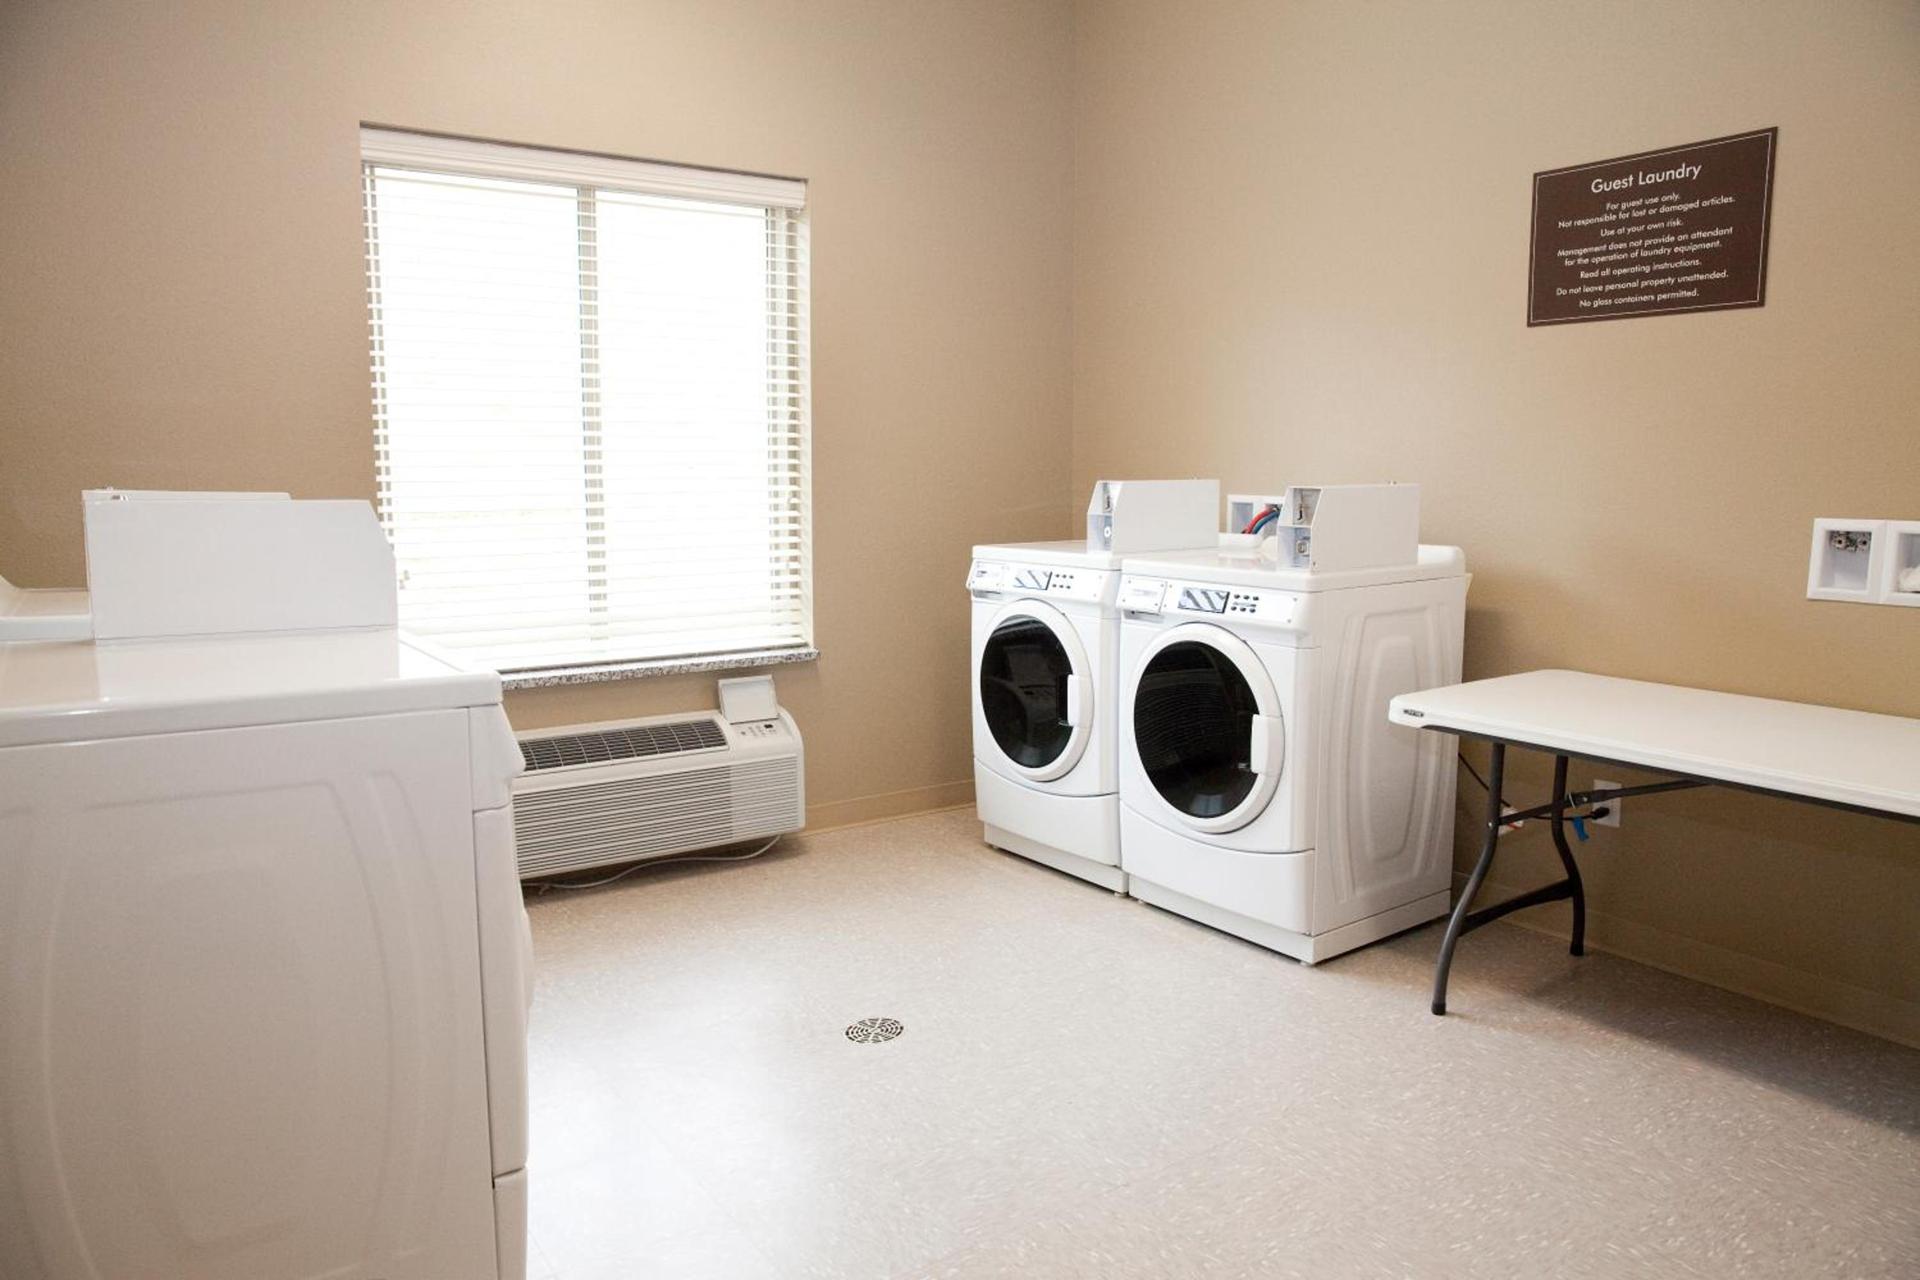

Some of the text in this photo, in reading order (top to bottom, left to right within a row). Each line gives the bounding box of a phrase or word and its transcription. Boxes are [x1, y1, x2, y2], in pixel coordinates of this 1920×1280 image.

[1591, 162, 1702, 193] Guest Laundry
[1558, 220, 1573, 228] Not
[1574, 213, 1616, 226] responsible
[1618, 211, 1630, 219] for
[1632, 208, 1647, 217] lost
[1660, 200, 1700, 214] damaged
[1702, 195, 1735, 206] articles.
[1606, 202, 1620, 210] For
[1622, 198, 1643, 210] guest
[1661, 192, 1680, 202] only.
[1600, 228, 1616, 236] Use
[1627, 225, 1645, 234] your
[1647, 222, 1664, 230] own
[1666, 218, 1683, 227] risk.
[1557, 244, 1606, 257] Management
[1608, 242, 1627, 250] does
[1628, 239, 1642, 247] not
[1644, 235, 1675, 247] provide
[1690, 227, 1733, 240] attendant
[1564, 258, 1576, 266] for
[1591, 252, 1628, 264] operation
[1630, 249, 1640, 258] of
[1640, 246, 1672, 257] laundry
[1674, 240, 1722, 253] equipment.
[1580, 258, 1702, 279] Read all operating instructions.
[1556, 270, 1728, 296] Do not leave personal property unattended.
[1580, 288, 1699, 308] No glass containers permitted.
